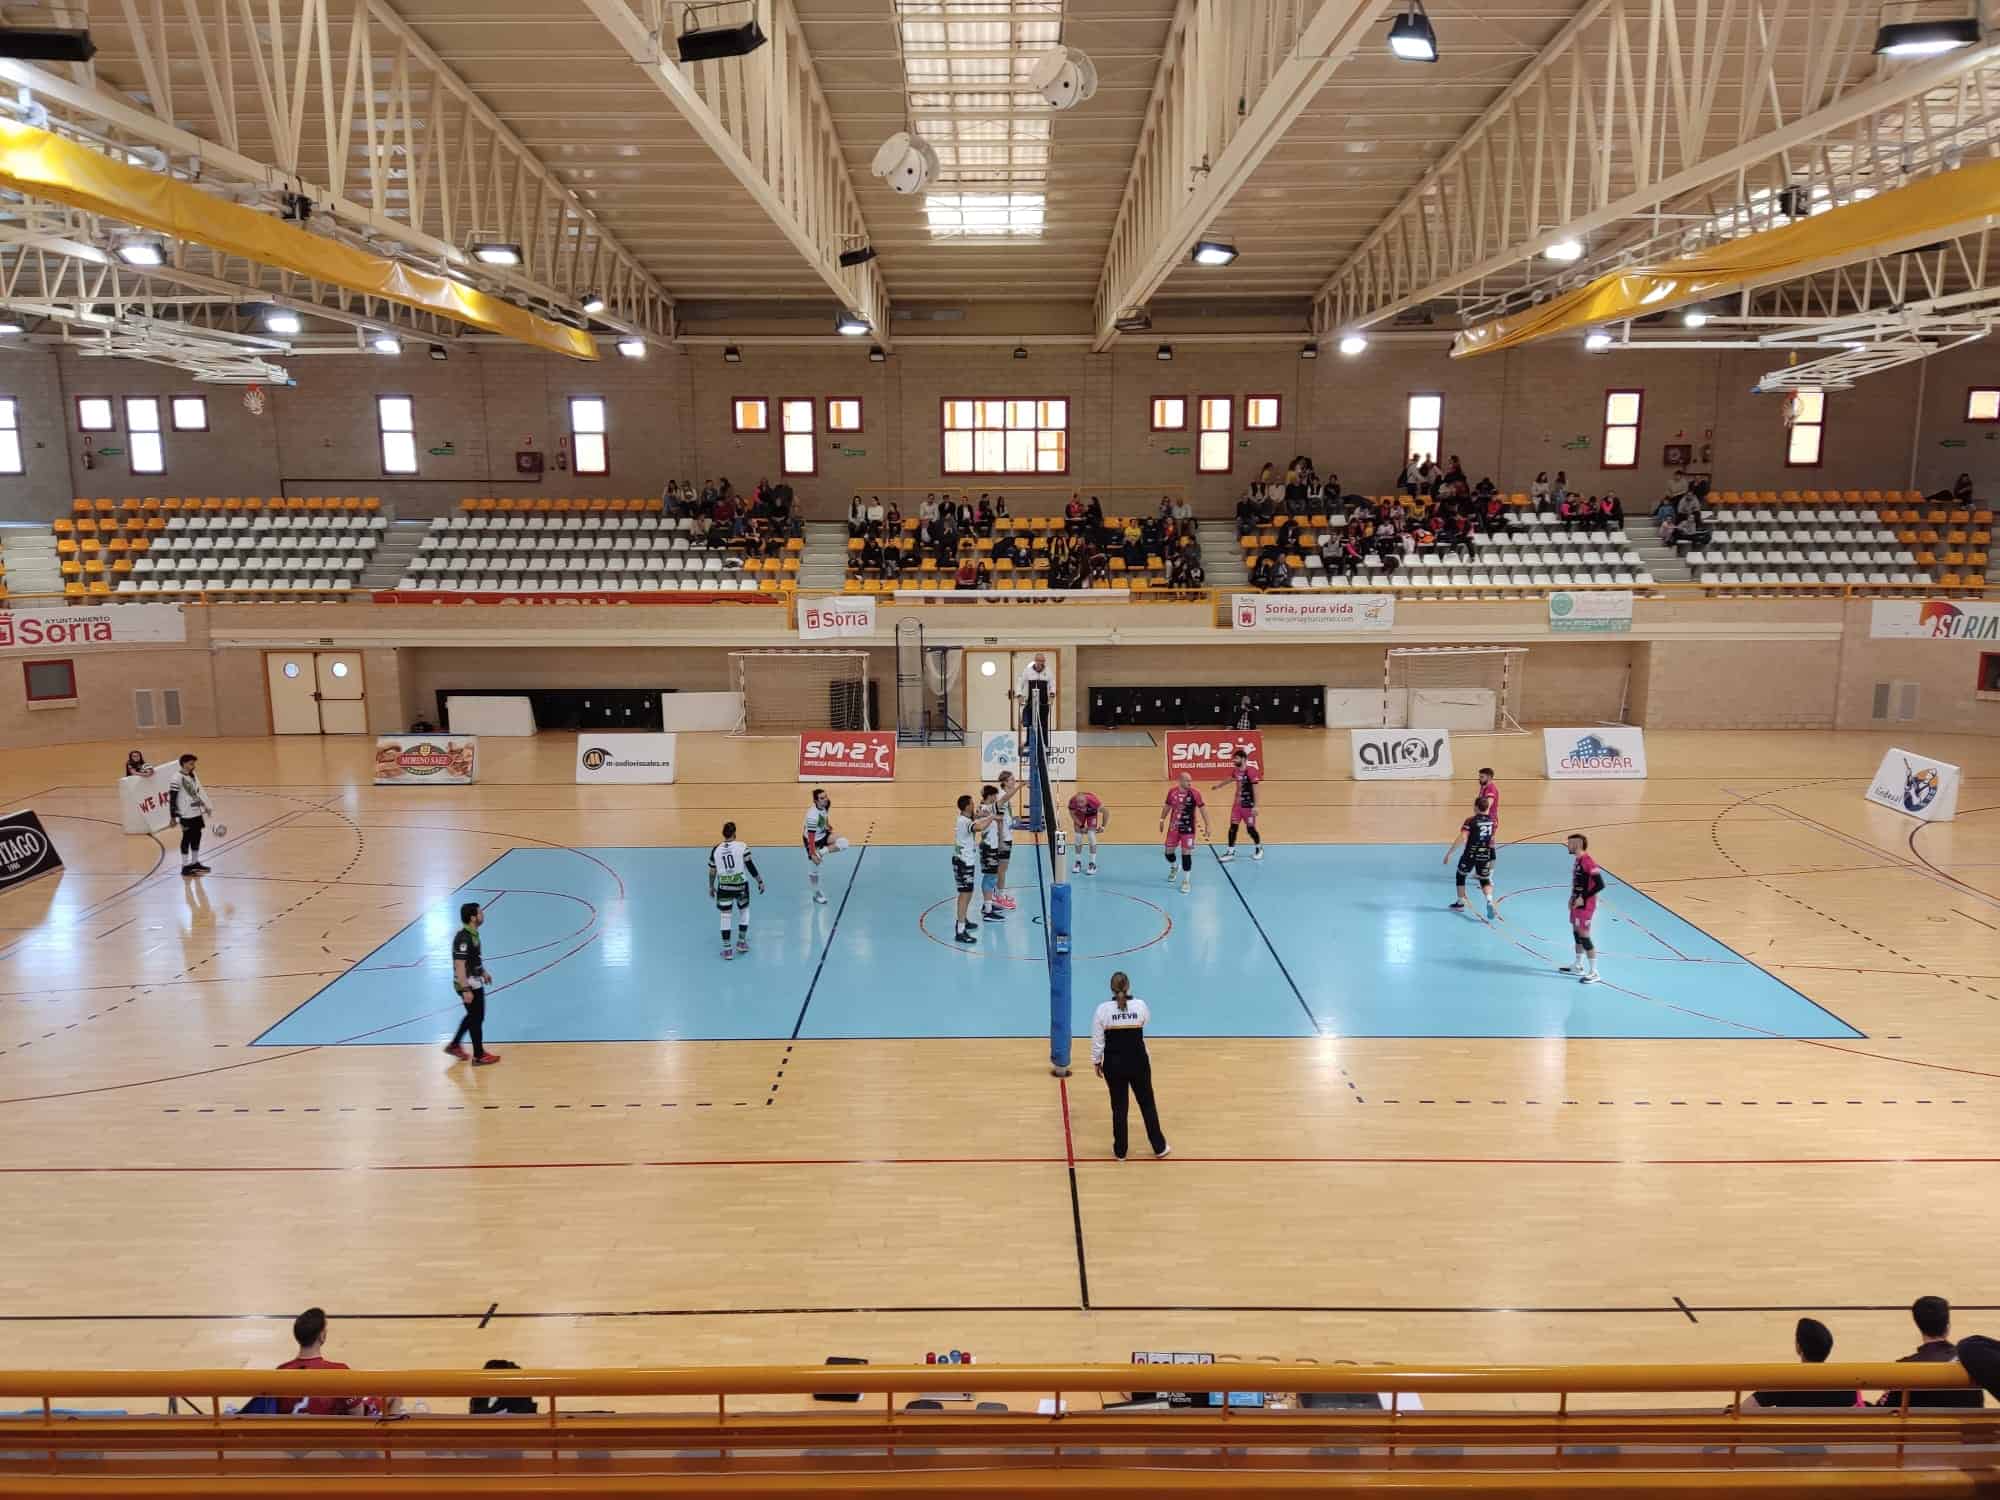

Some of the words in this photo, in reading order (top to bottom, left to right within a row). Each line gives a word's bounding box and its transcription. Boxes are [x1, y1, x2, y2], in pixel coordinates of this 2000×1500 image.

[1265, 604, 1297, 614] Soria,
[1301, 606, 1326, 616] pura
[1330, 603, 1353, 614] vida
[45, 616, 110, 624] AYUNTAMIENTO
[823, 612, 868, 627] Soria
[19, 619, 112, 645] Soria
[804, 741, 867, 759] SM-2
[1172, 742, 1233, 760] SM-2
[1561, 757, 1633, 769] CALOGAR
[139, 796, 155, 813] WE
[1480, 825, 1493, 837] 21
[0, 832, 40, 866] TIAGO
[722, 854, 735, 869] 10
